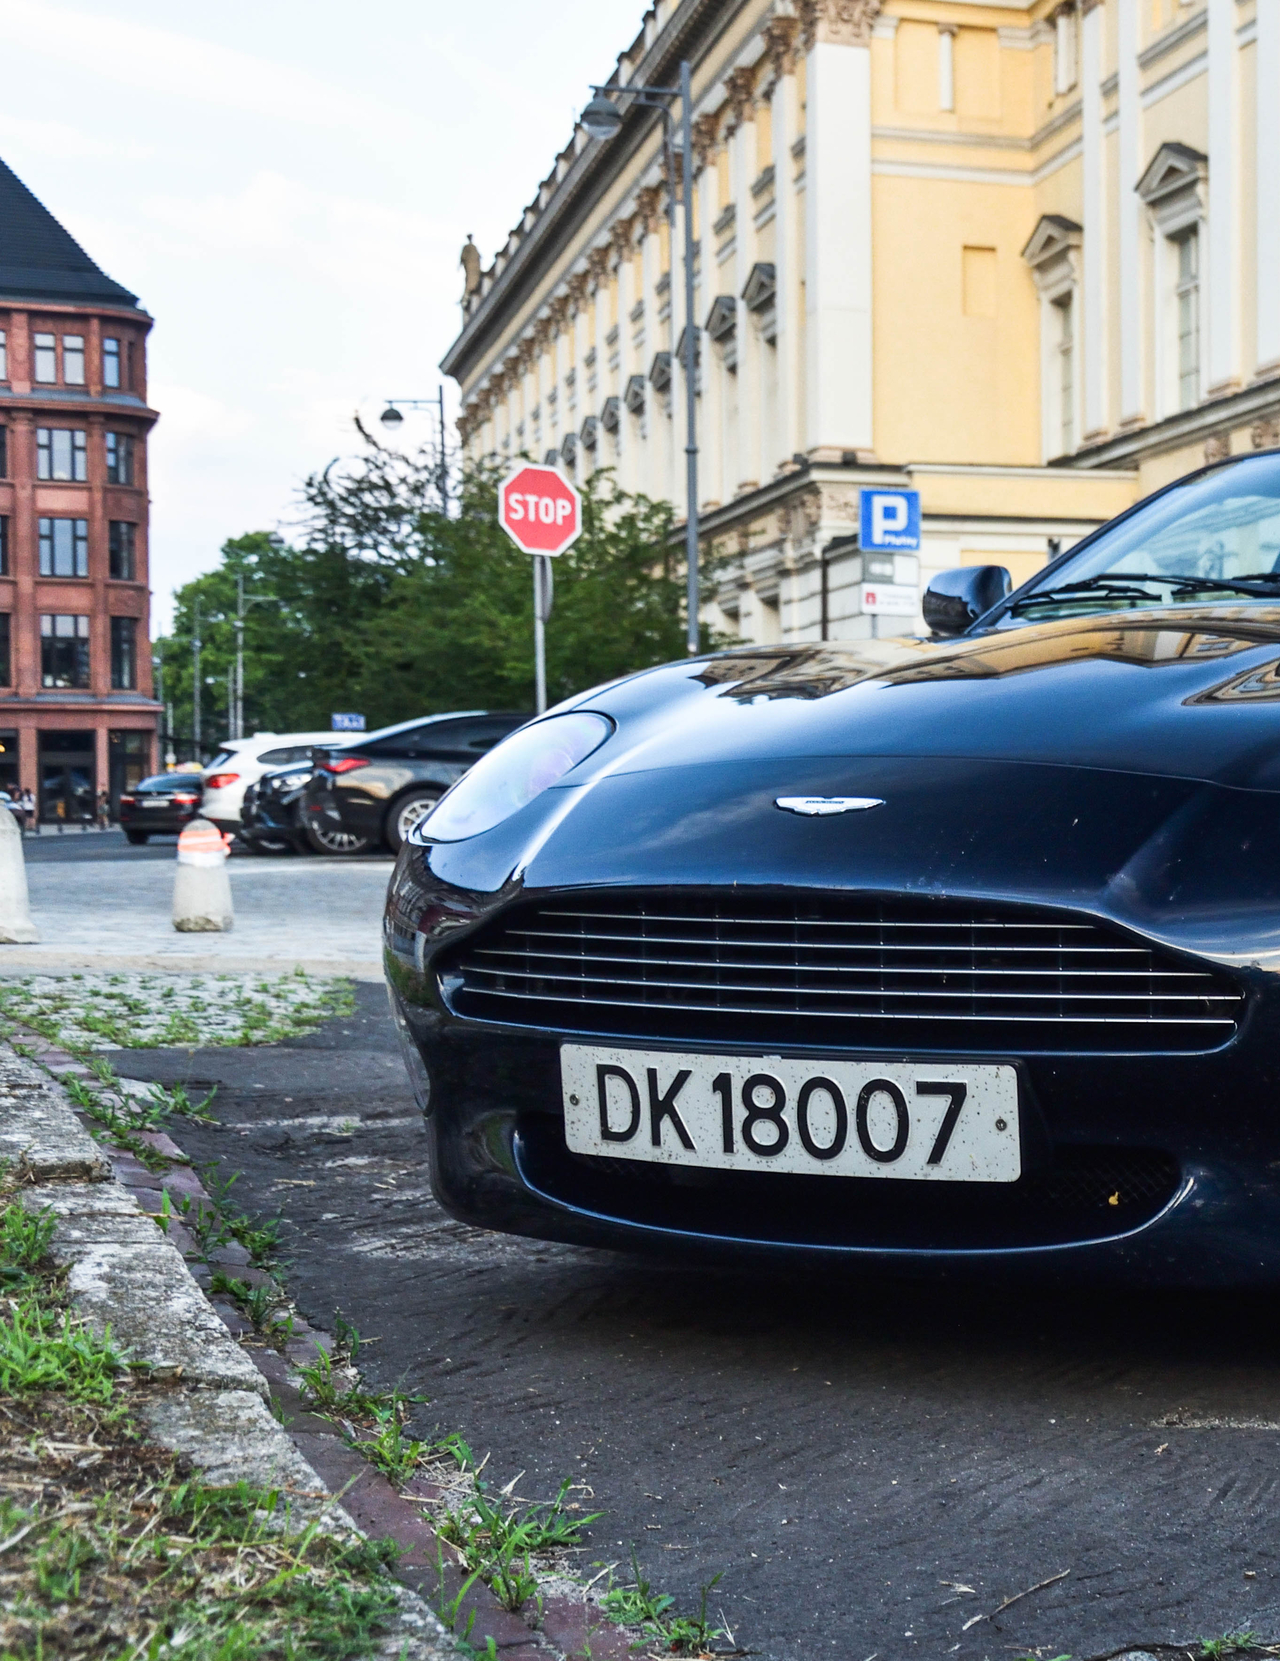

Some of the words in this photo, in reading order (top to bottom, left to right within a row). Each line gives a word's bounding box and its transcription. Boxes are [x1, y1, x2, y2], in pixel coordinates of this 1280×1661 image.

[508, 493, 572, 526] STOP
[872, 495, 909, 545] P
[596, 1063, 698, 1152] DK
[711, 1071, 969, 1166] 18007
